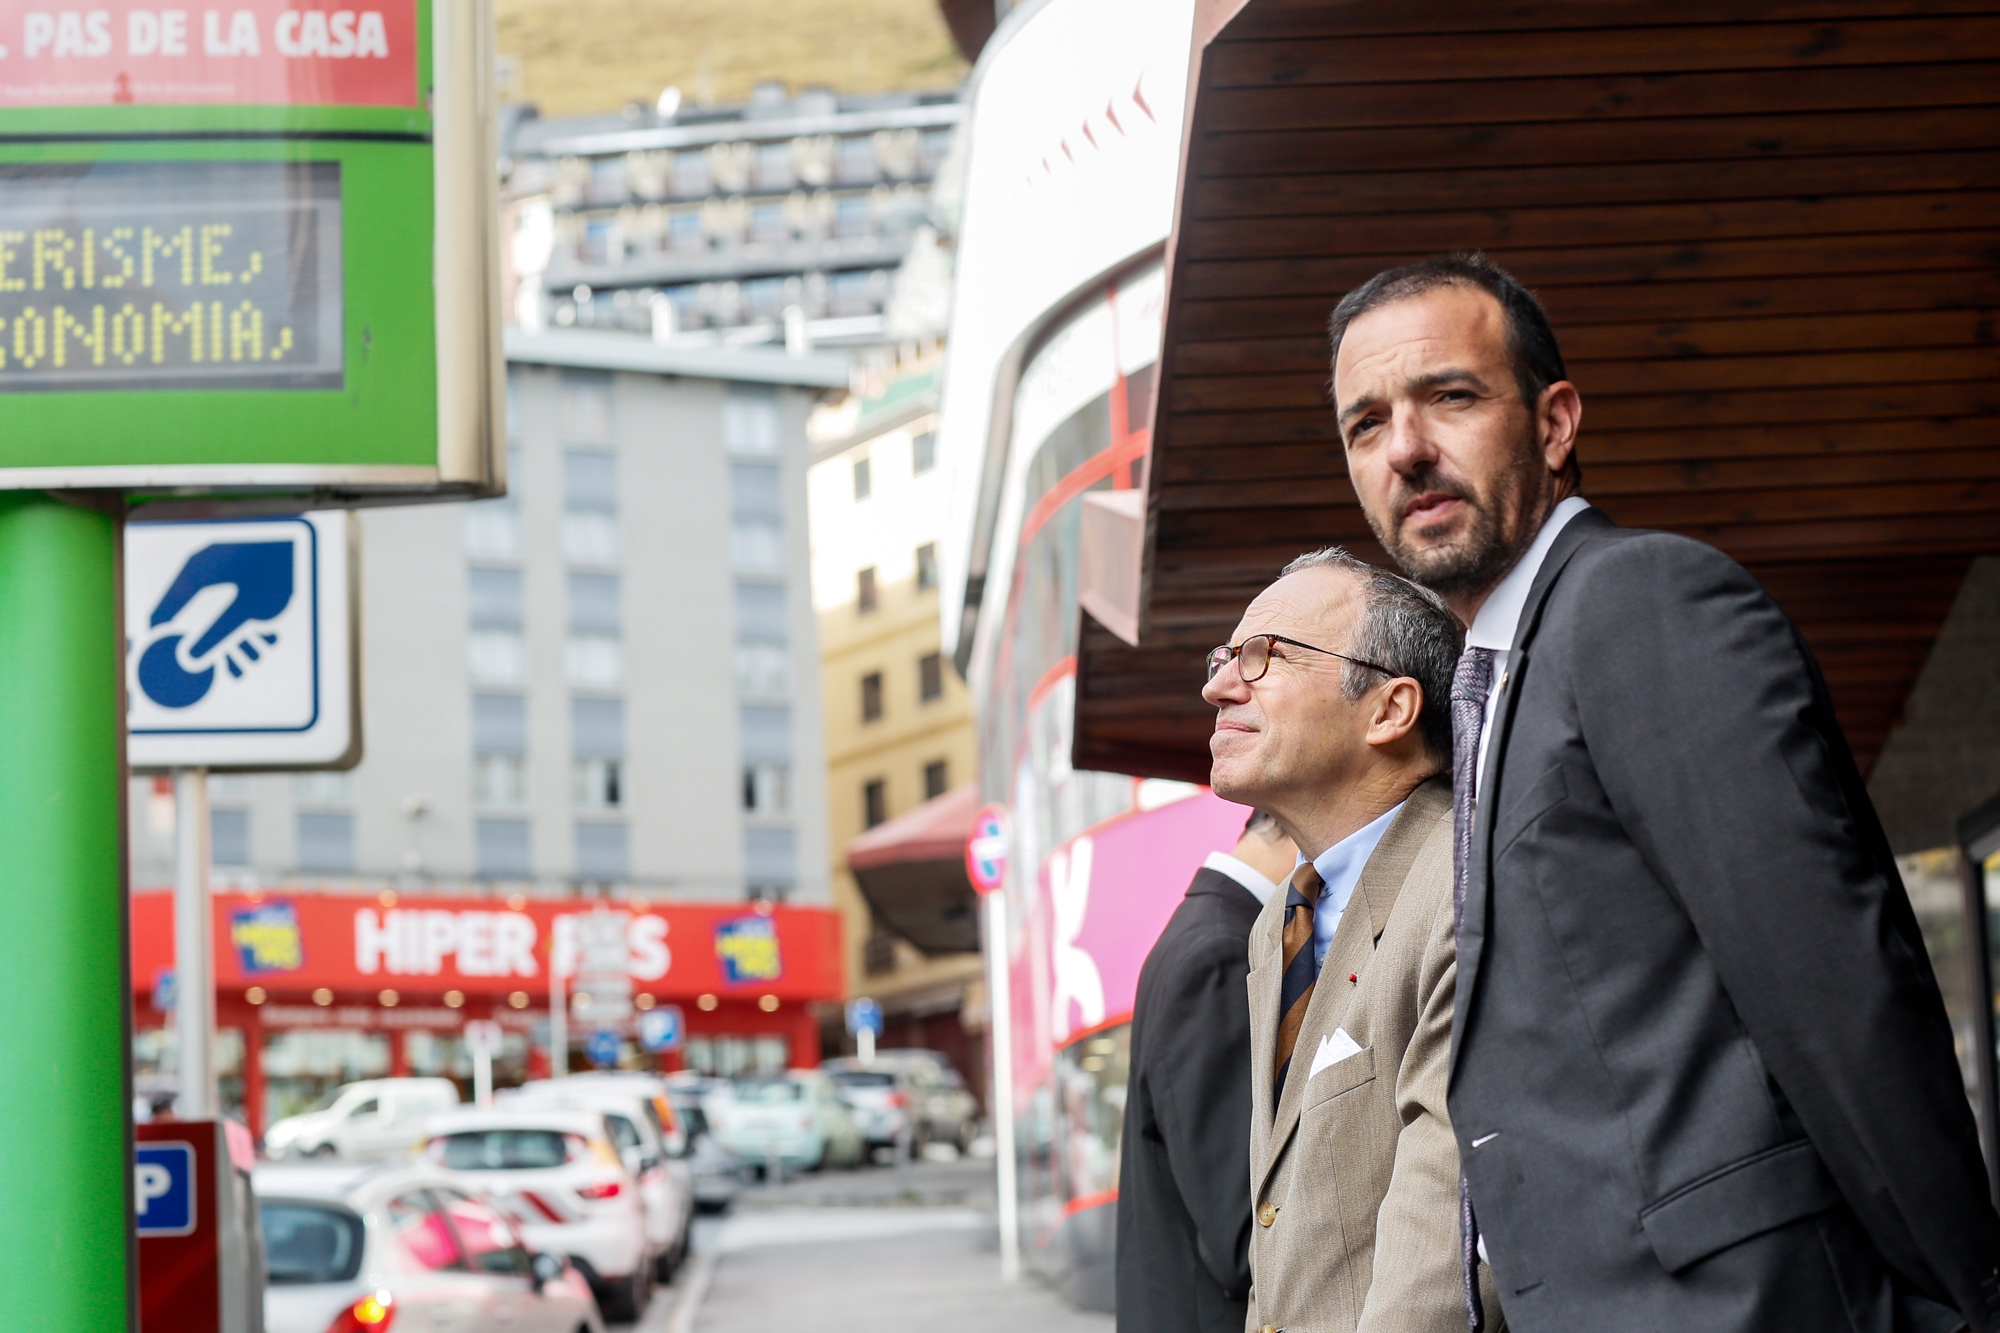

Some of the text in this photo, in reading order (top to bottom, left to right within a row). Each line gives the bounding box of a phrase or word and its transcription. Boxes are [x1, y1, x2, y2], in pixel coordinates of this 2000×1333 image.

[23, 9, 390, 58] PAS DE LA CASA
[0, 300, 293, 369] ONOMIA,
[355, 908, 537, 978] HIPER
[134, 1163, 172, 1216] P
